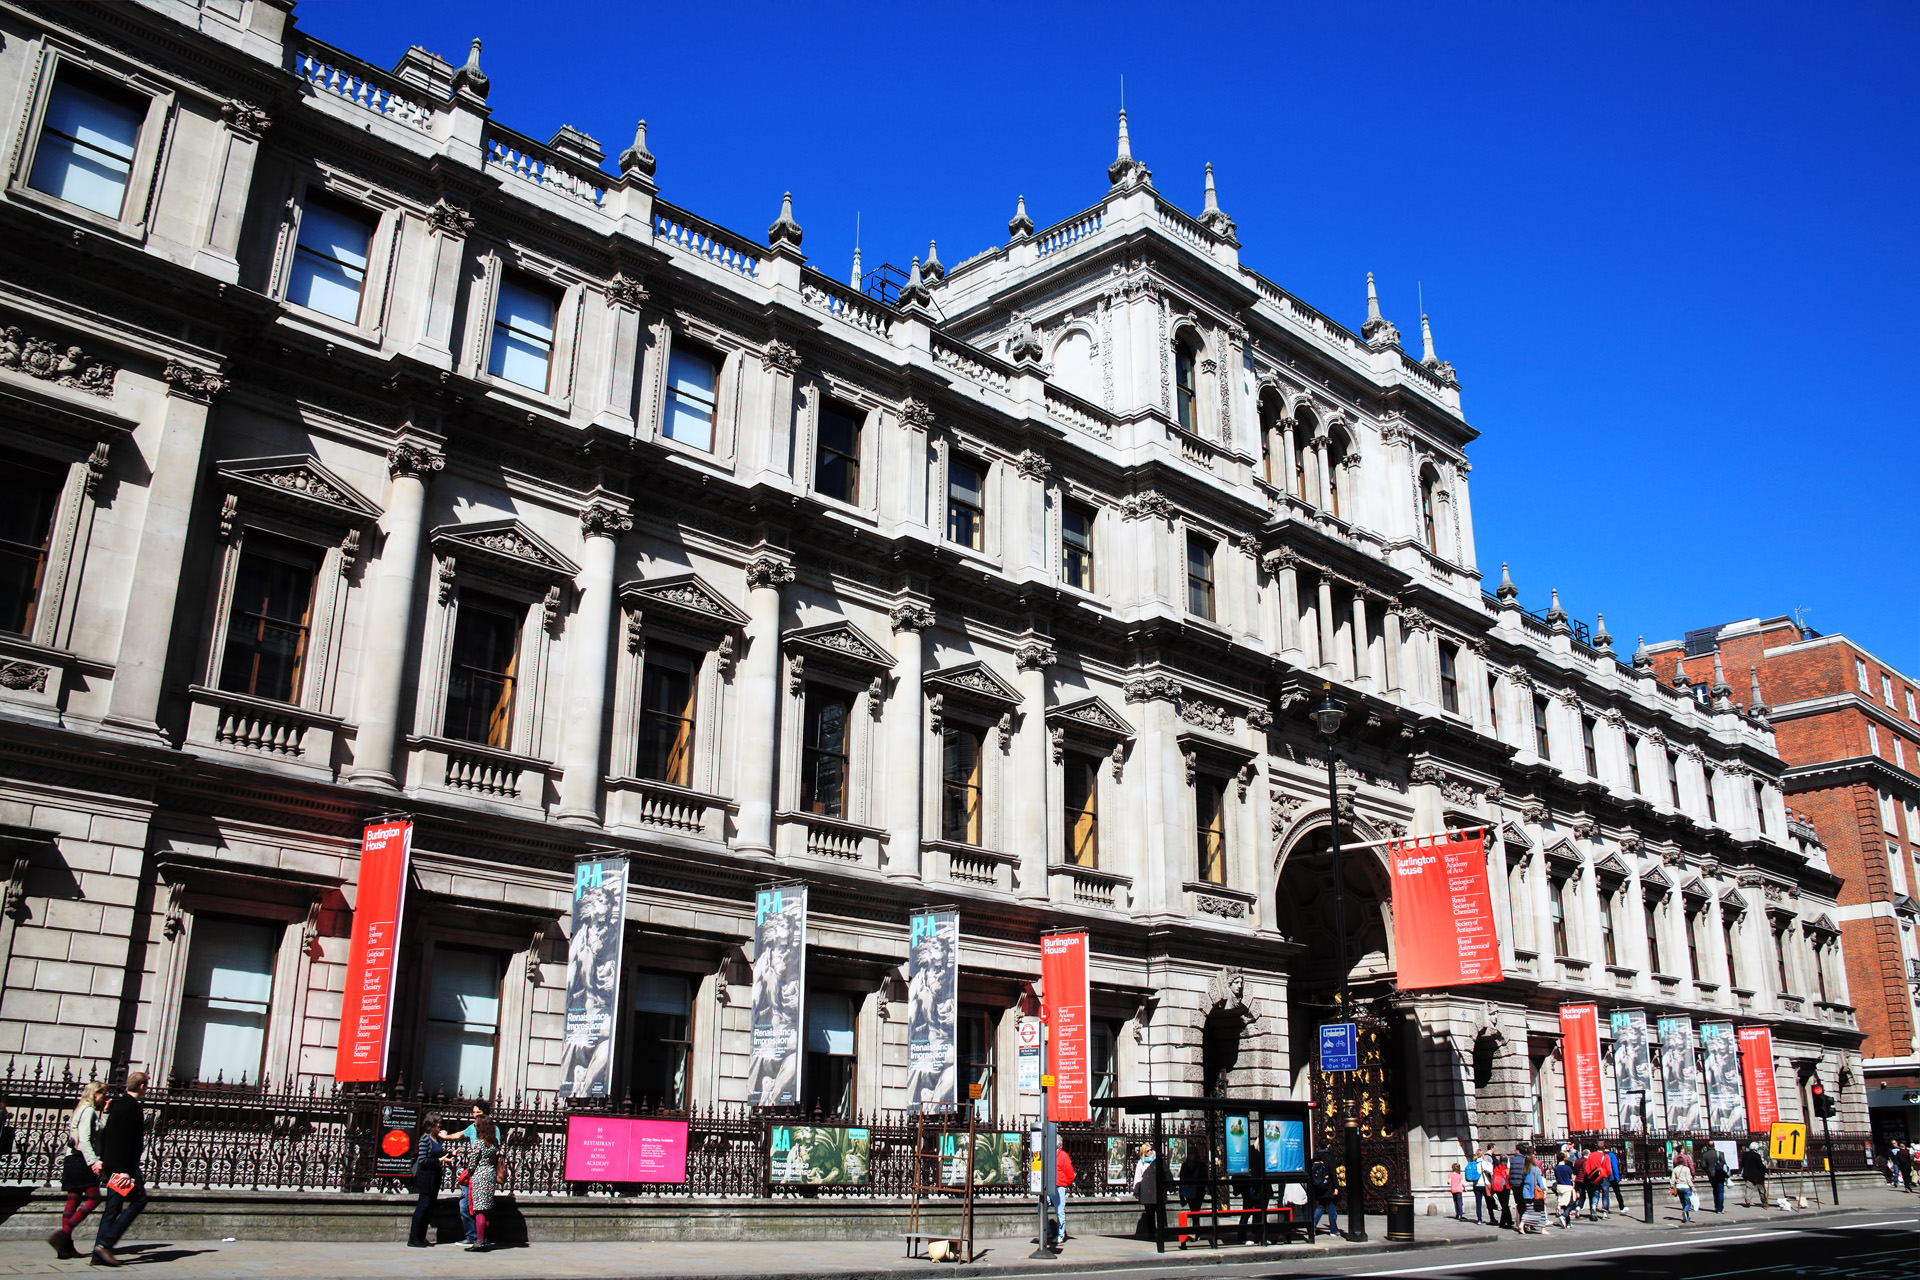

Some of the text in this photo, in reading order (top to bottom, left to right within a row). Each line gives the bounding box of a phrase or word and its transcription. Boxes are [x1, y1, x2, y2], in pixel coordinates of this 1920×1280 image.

[366, 827, 400, 841] Burlington
[365, 840, 386, 851] House
[1444, 856, 1458, 864] Royal
[1446, 861, 1468, 869] Academy
[1448, 878, 1474, 887] Geological
[1450, 884, 1467, 892] Society
[1451, 897, 1466, 905] Royal
[1452, 902, 1470, 910] Society
[1456, 925, 1483, 933] Antiquaries
[1044, 937, 1079, 947] Burlington
[1457, 938, 1472, 946] Royal
[1040, 1006, 1046, 1018] L
[1561, 1007, 1590, 1015] Burlington
[567, 1012, 609, 1022] Renaissance
[753, 1028, 794, 1037] Renaissance
[910, 1043, 952, 1052] Renaissance
[773, 1128, 790, 1151] RA
